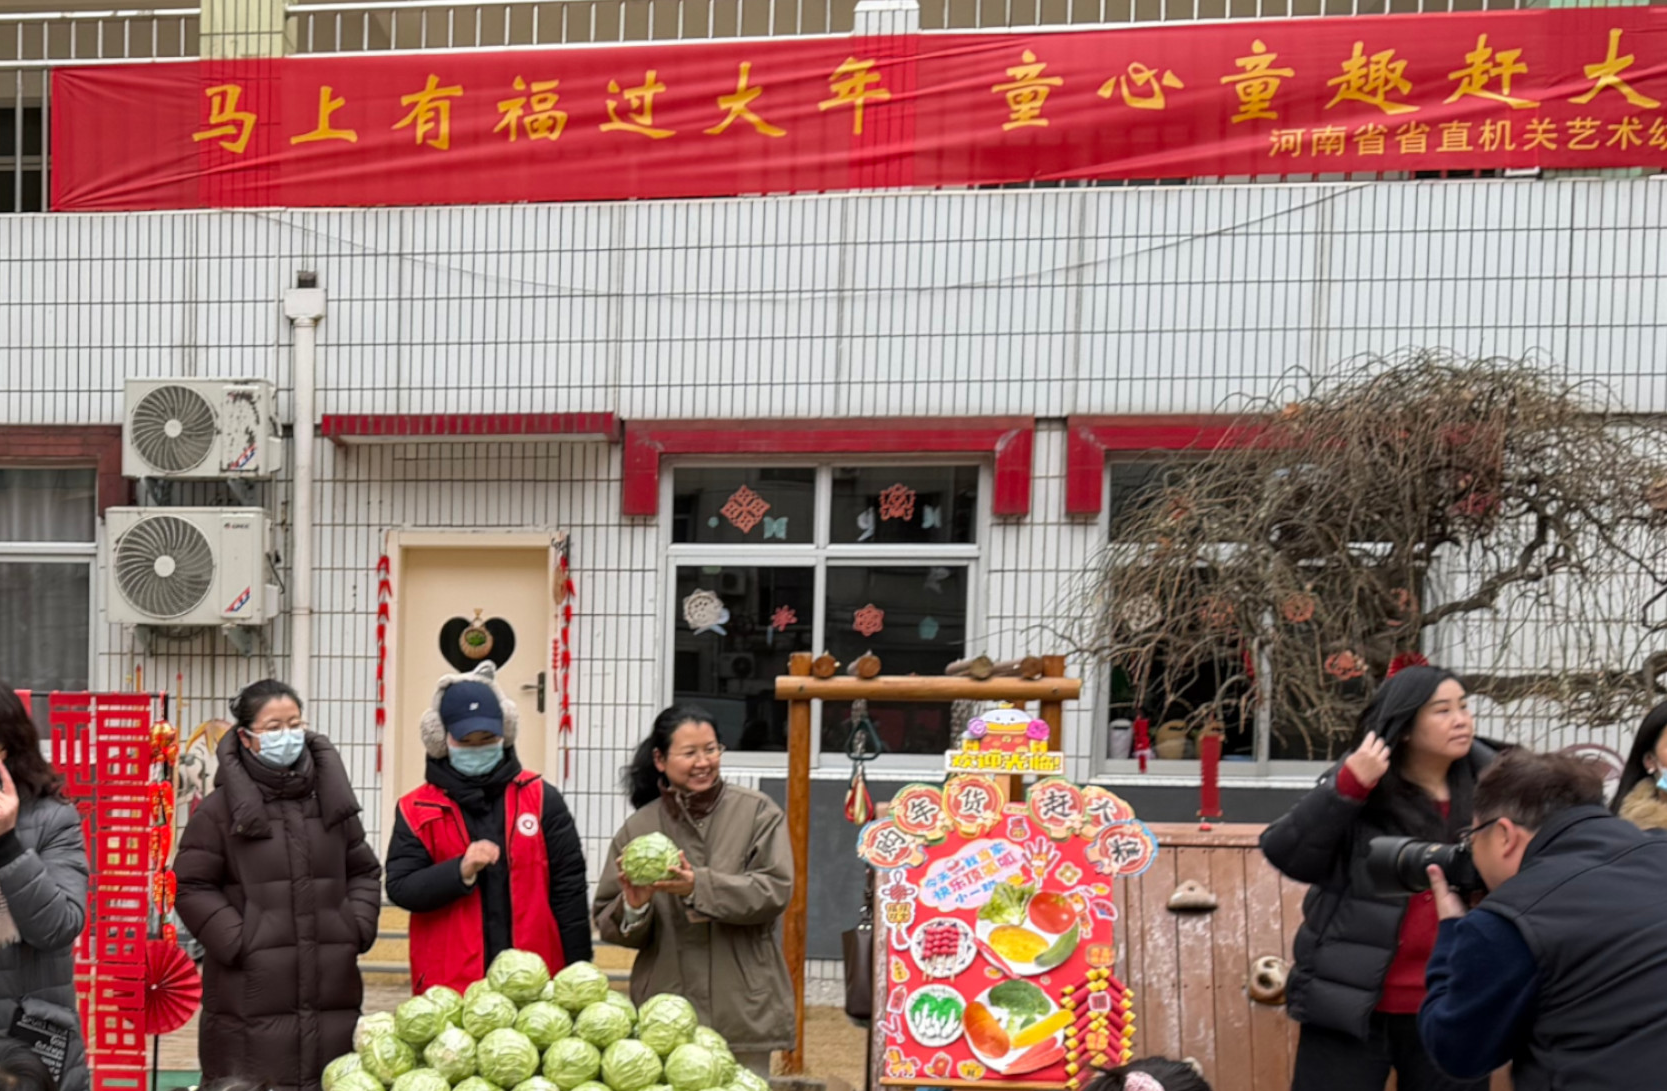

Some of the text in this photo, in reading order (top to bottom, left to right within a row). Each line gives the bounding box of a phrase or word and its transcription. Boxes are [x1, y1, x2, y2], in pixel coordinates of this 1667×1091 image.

[191, 27, 1663, 154] 马上有福过大年 童心童趣赶大
[874, 786, 987, 860] 购年货
